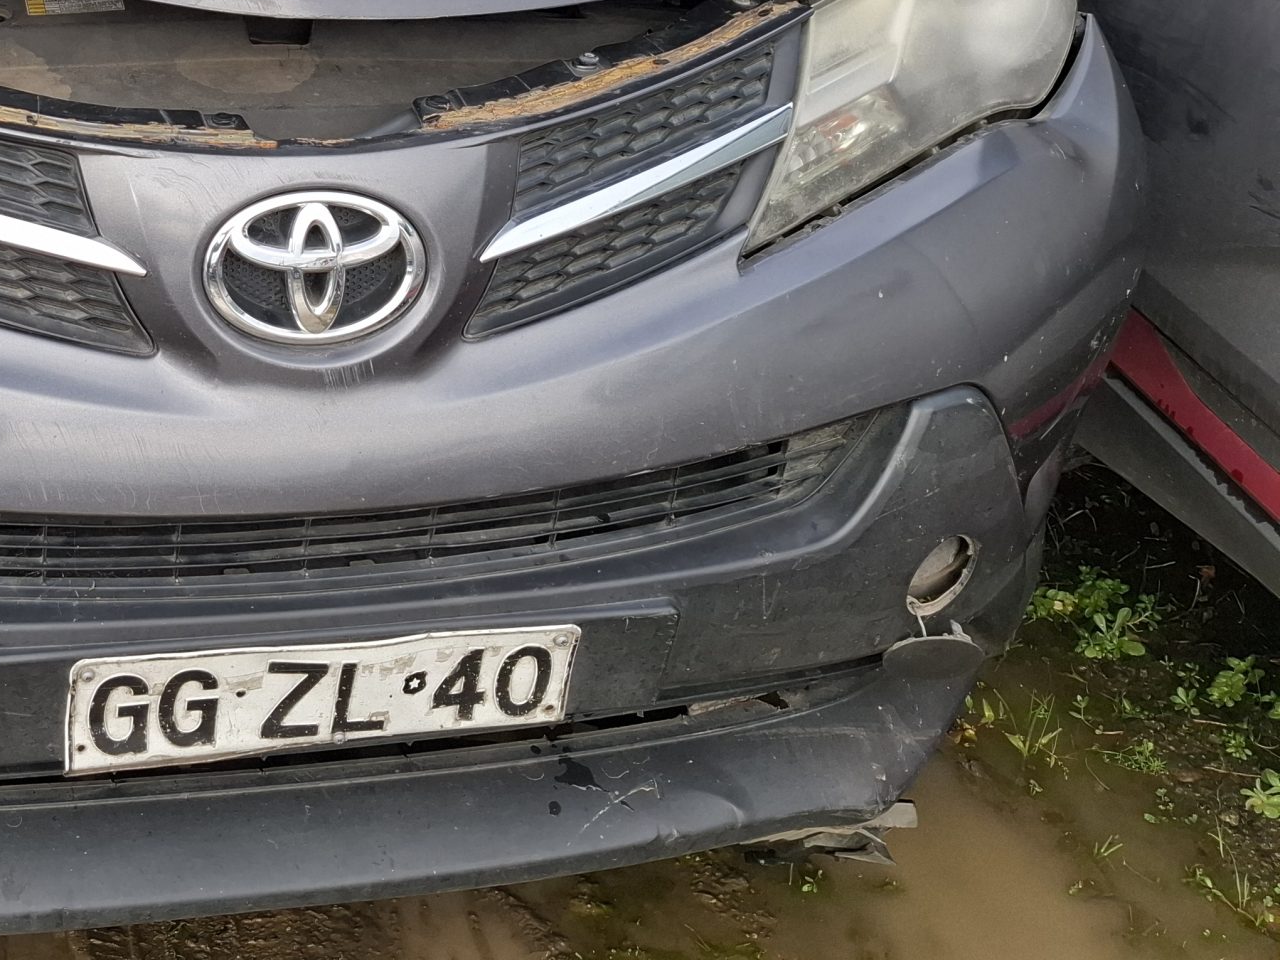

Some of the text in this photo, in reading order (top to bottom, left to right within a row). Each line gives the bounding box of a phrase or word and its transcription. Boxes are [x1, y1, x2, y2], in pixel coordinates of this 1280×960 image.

[88, 644, 552, 756] GG ZL 40
